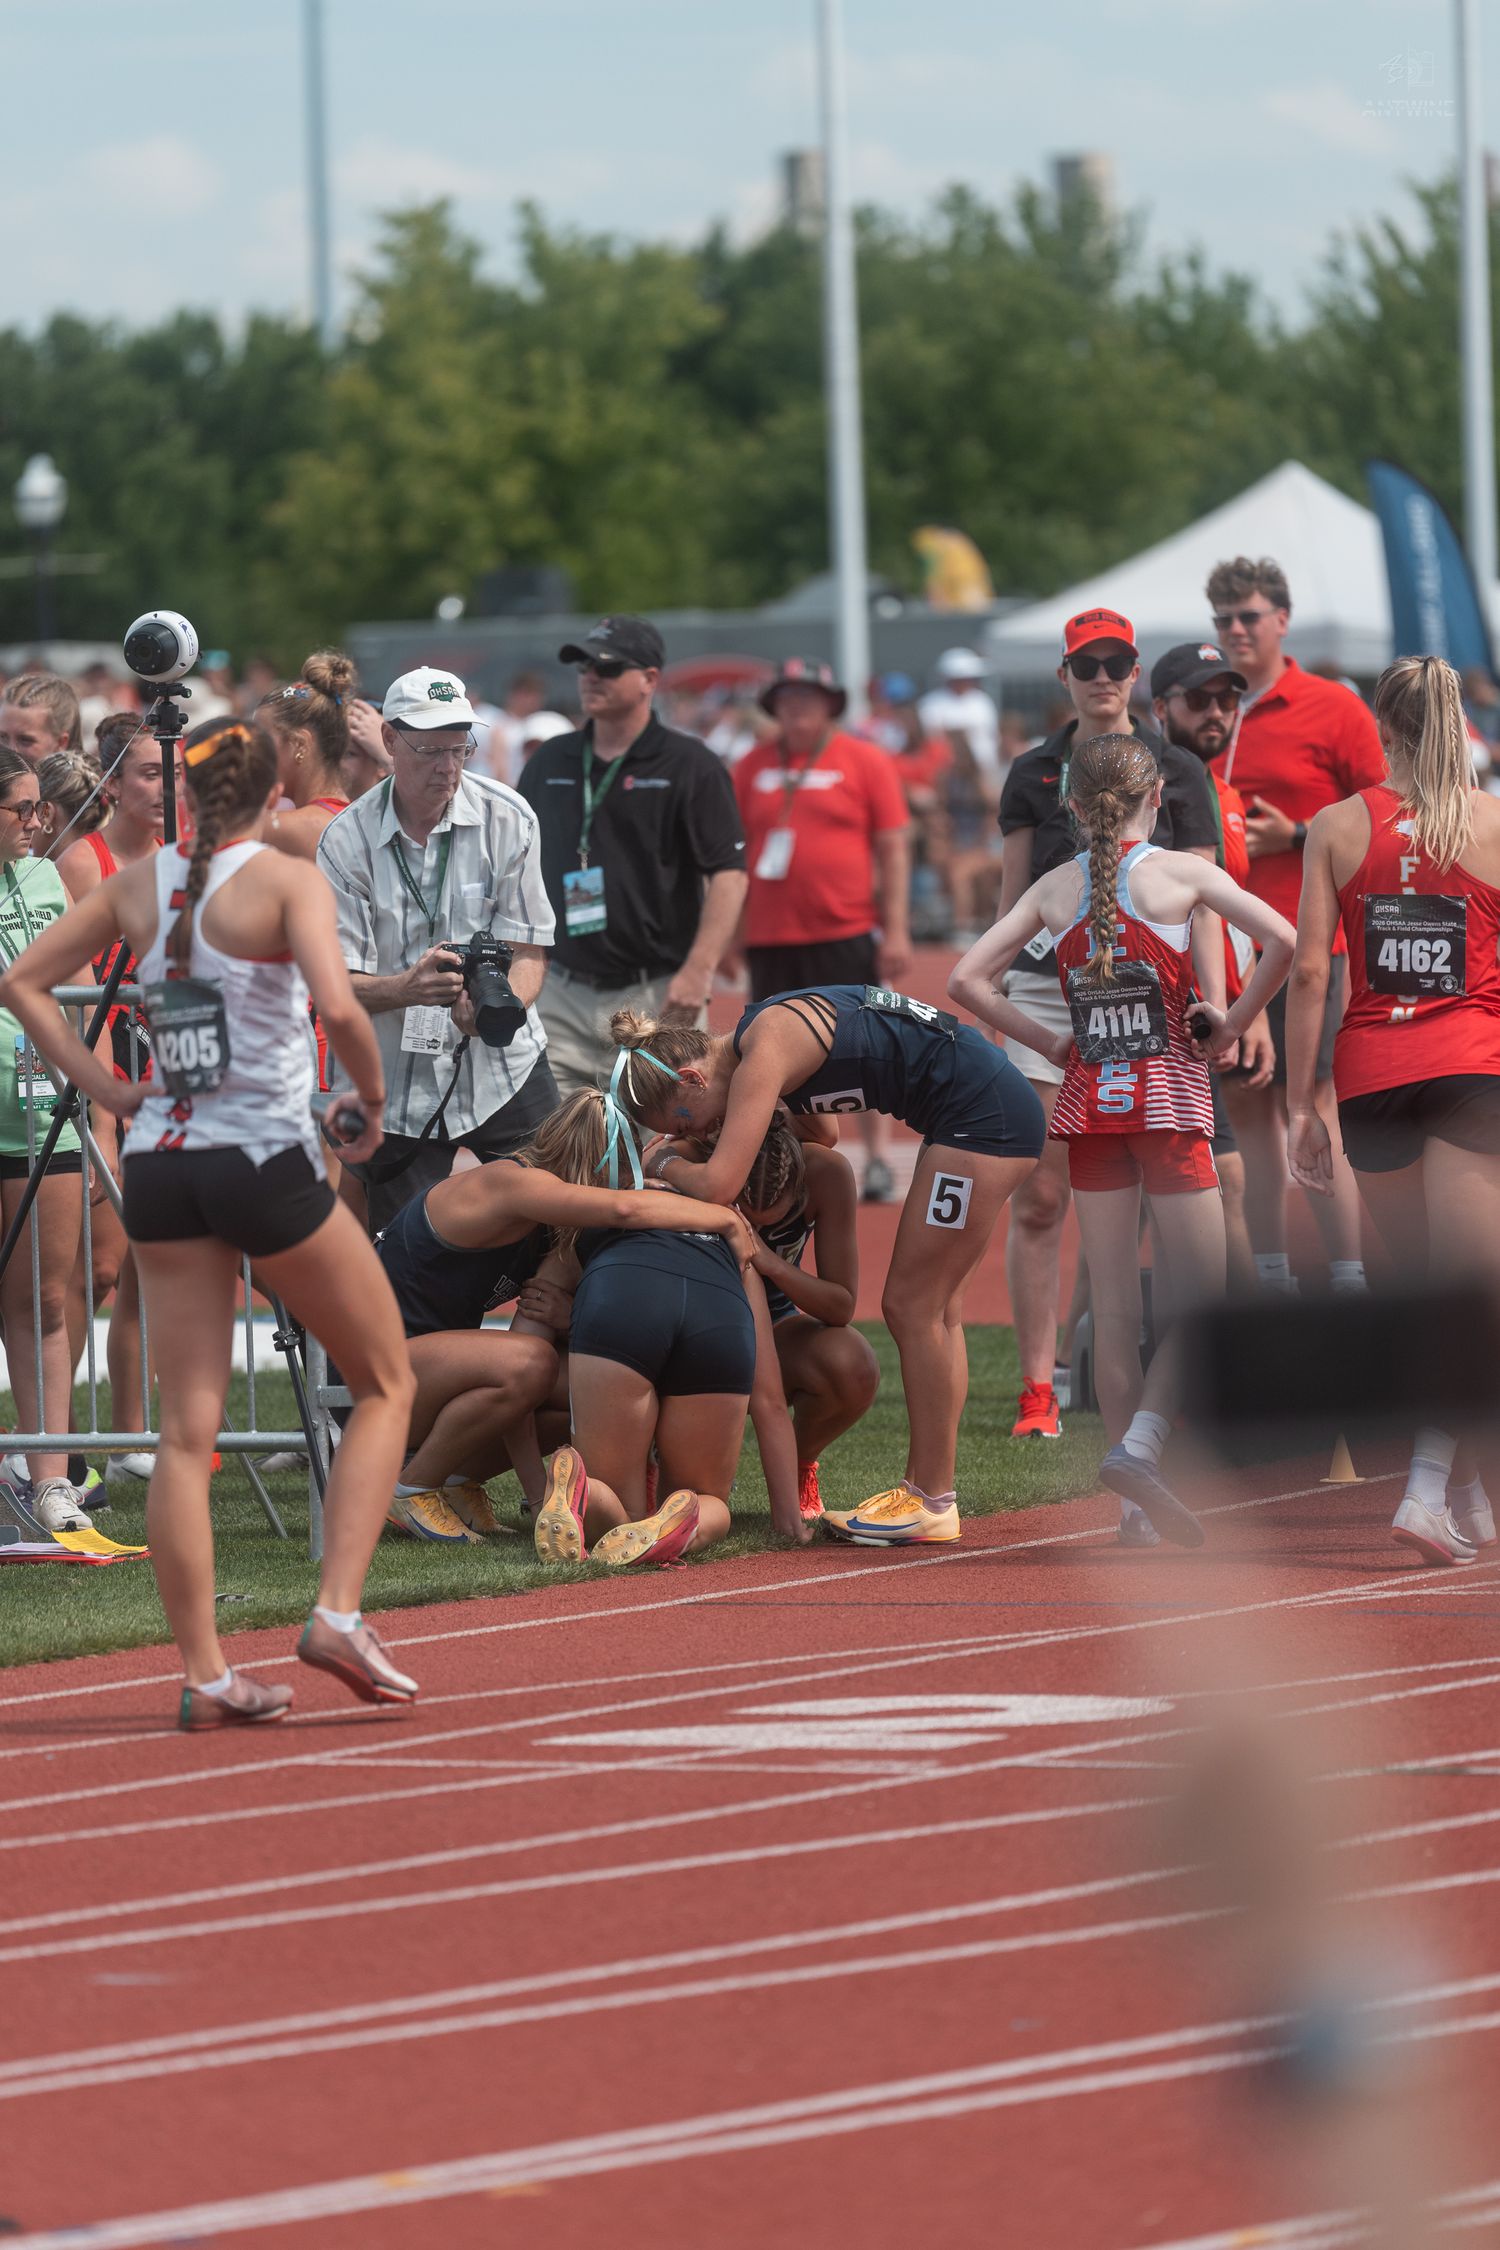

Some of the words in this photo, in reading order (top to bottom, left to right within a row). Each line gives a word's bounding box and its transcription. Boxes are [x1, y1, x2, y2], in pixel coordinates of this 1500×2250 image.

[429, 685, 460, 698] OHSAA
[0, 911, 21, 922] TRAC
[34, 909, 52, 920] FIELD
[1375, 905, 1400, 914] OHSAA
[1378, 938, 1451, 973] 4162
[1110, 991, 1150, 999] Championships
[907, 996, 938, 1022] 43
[1088, 1002, 1151, 1038] 4114
[932, 1177, 964, 1224] 5
[529, 1693, 1177, 1752] 2
